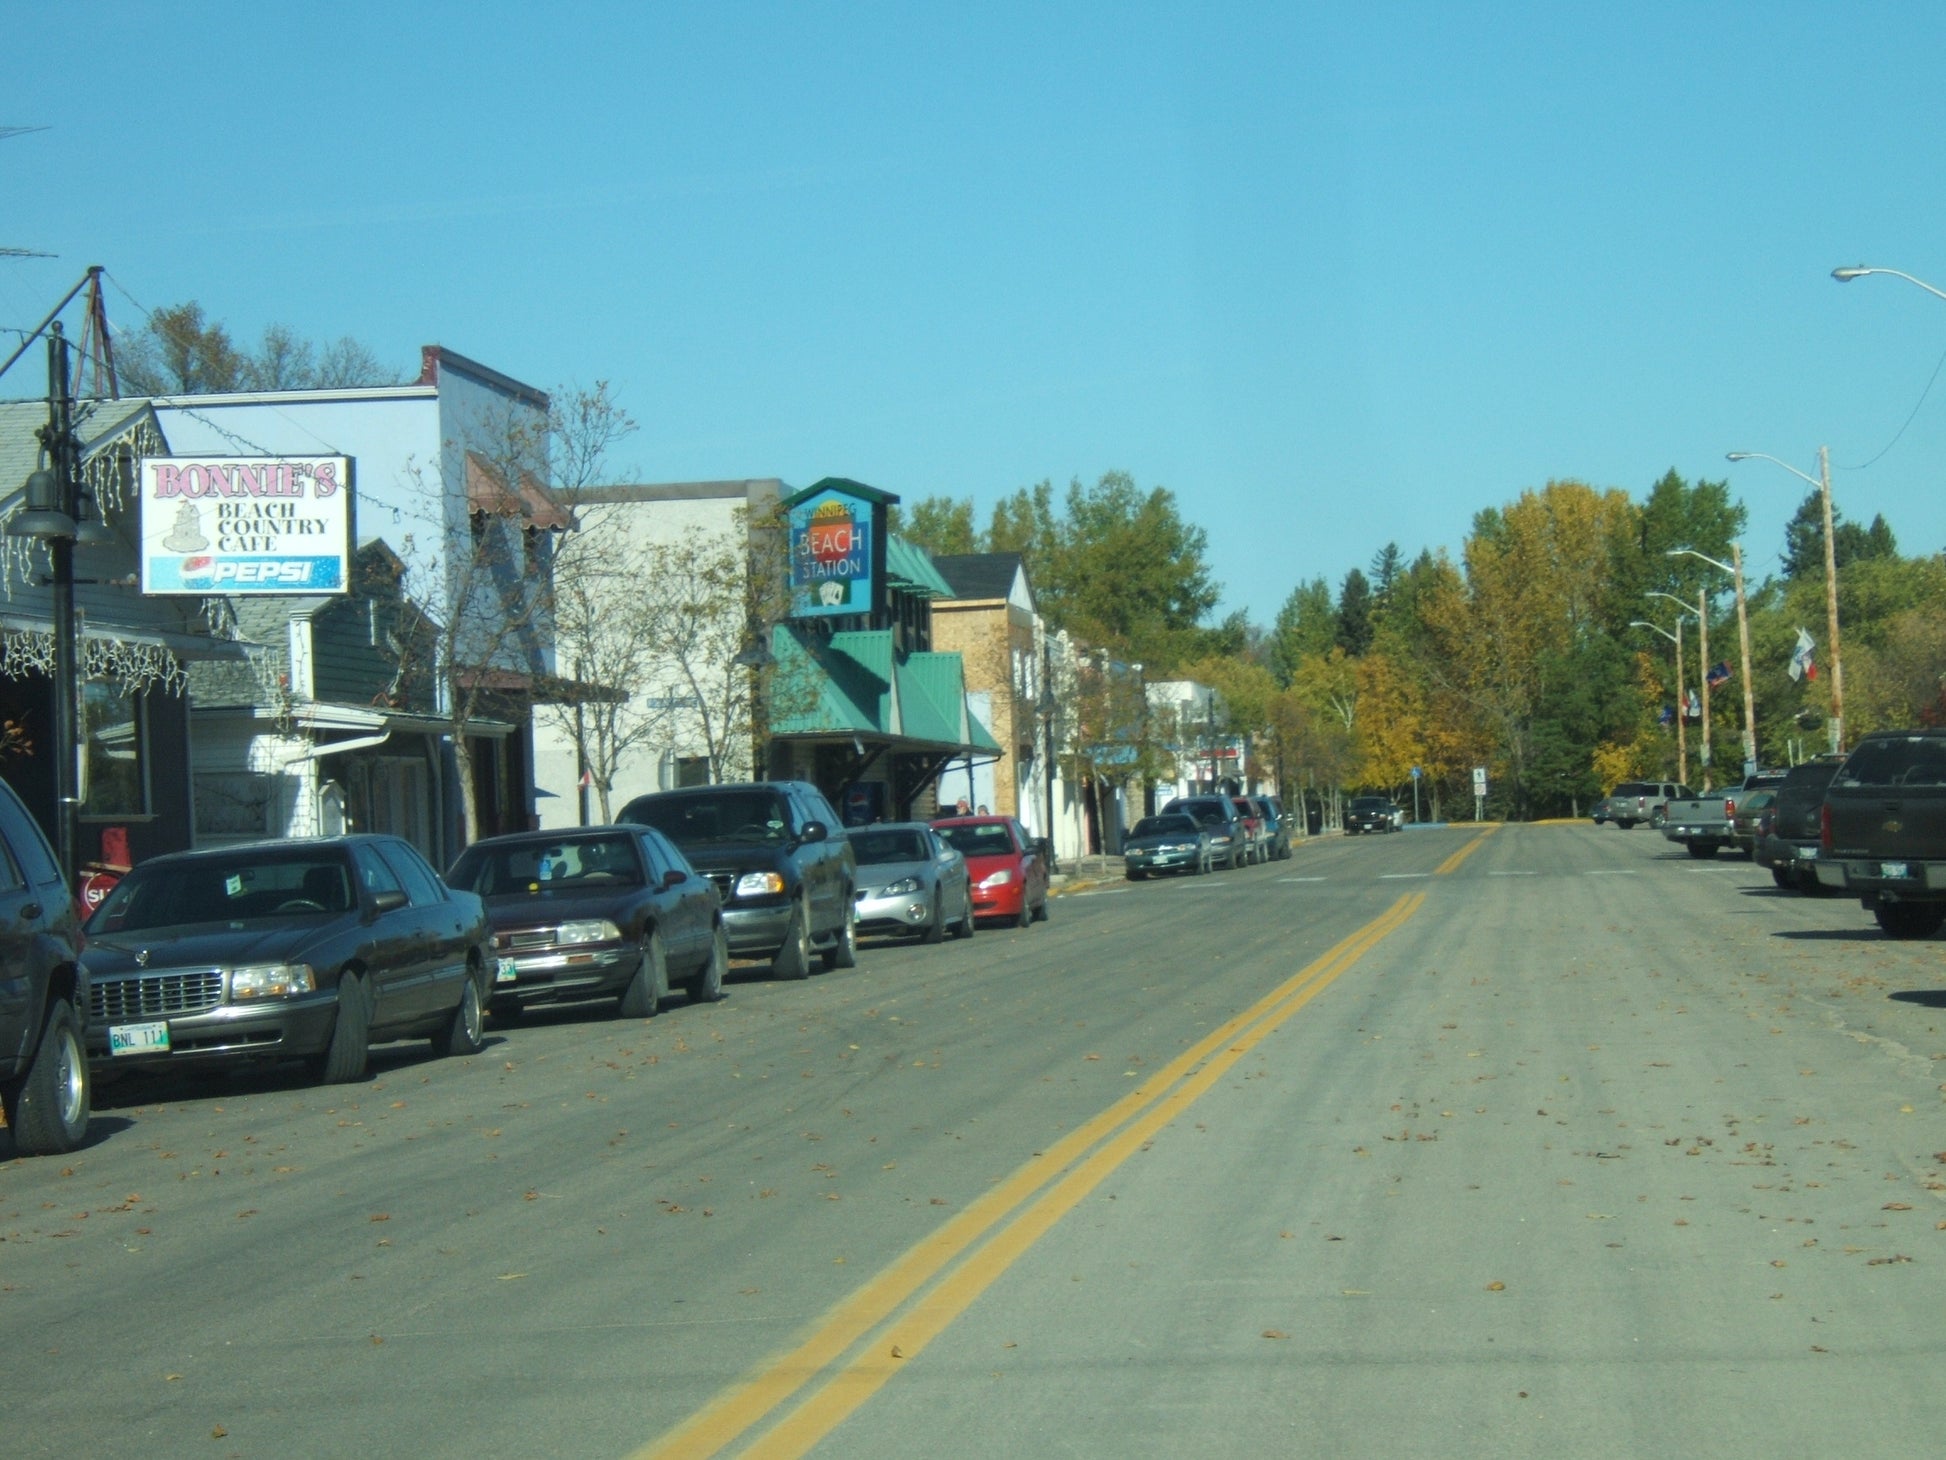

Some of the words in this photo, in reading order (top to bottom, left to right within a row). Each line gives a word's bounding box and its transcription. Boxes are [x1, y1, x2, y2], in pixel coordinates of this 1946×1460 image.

[151, 462, 337, 498] BONNIE'S
[217, 502, 296, 519] BEACH
[805, 502, 857, 519] WINNIPEG
[217, 518, 329, 535] COUNTRY
[217, 535, 278, 552] CAFE
[800, 528, 862, 556] BEACH
[213, 560, 313, 584] PEPSI
[802, 558, 861, 579] STATION
[113, 1032, 136, 1048] BNL
